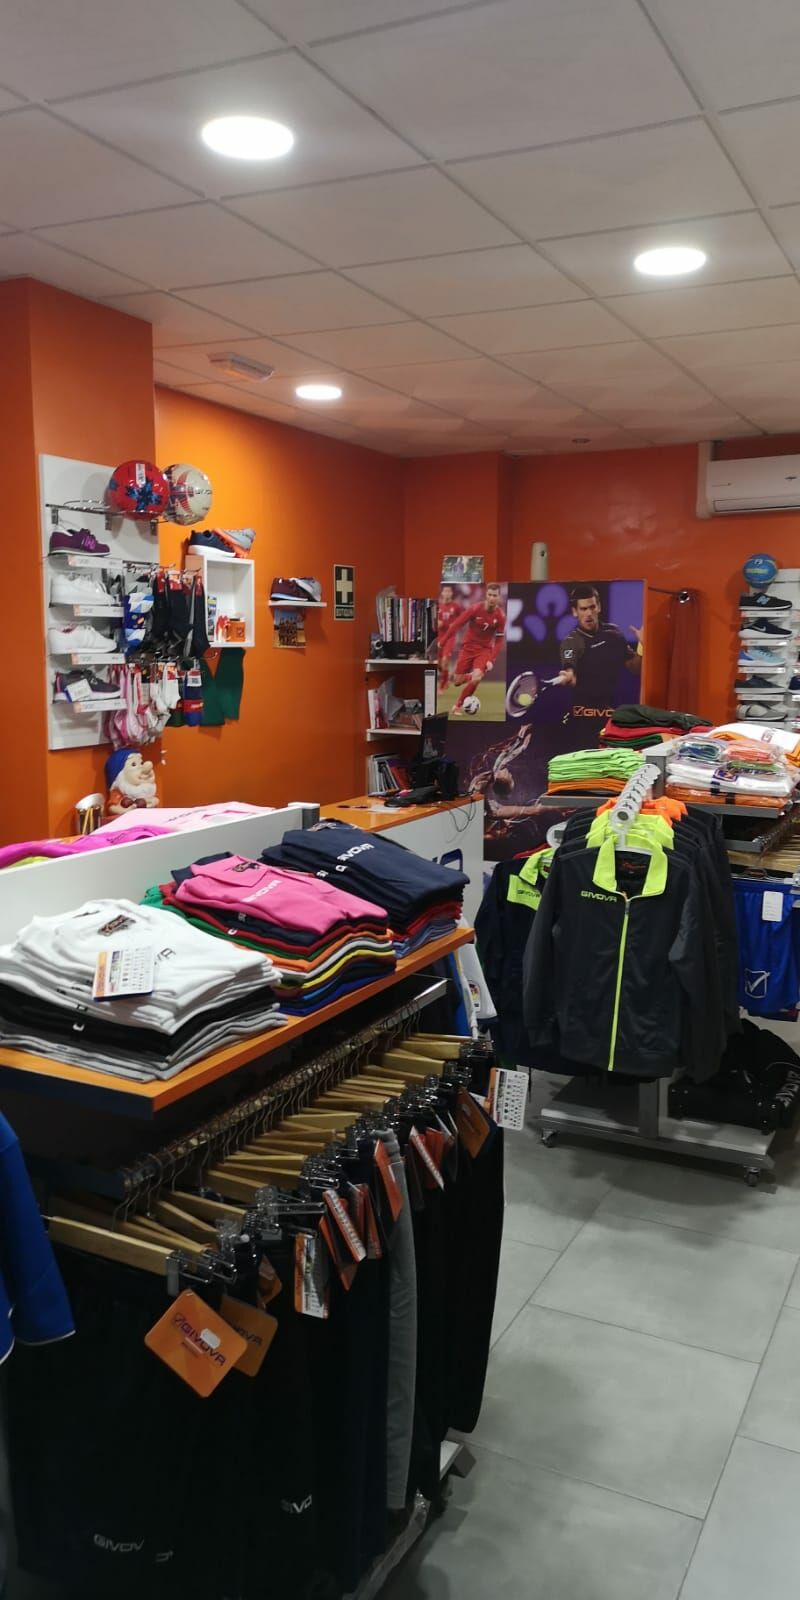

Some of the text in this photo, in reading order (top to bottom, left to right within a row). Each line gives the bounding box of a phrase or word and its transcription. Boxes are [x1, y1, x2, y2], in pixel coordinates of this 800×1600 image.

[583, 708, 616, 717] GIVO
[580, 890, 618, 903] GIVOVA
[181, 1322, 226, 1366] GIVOVA
